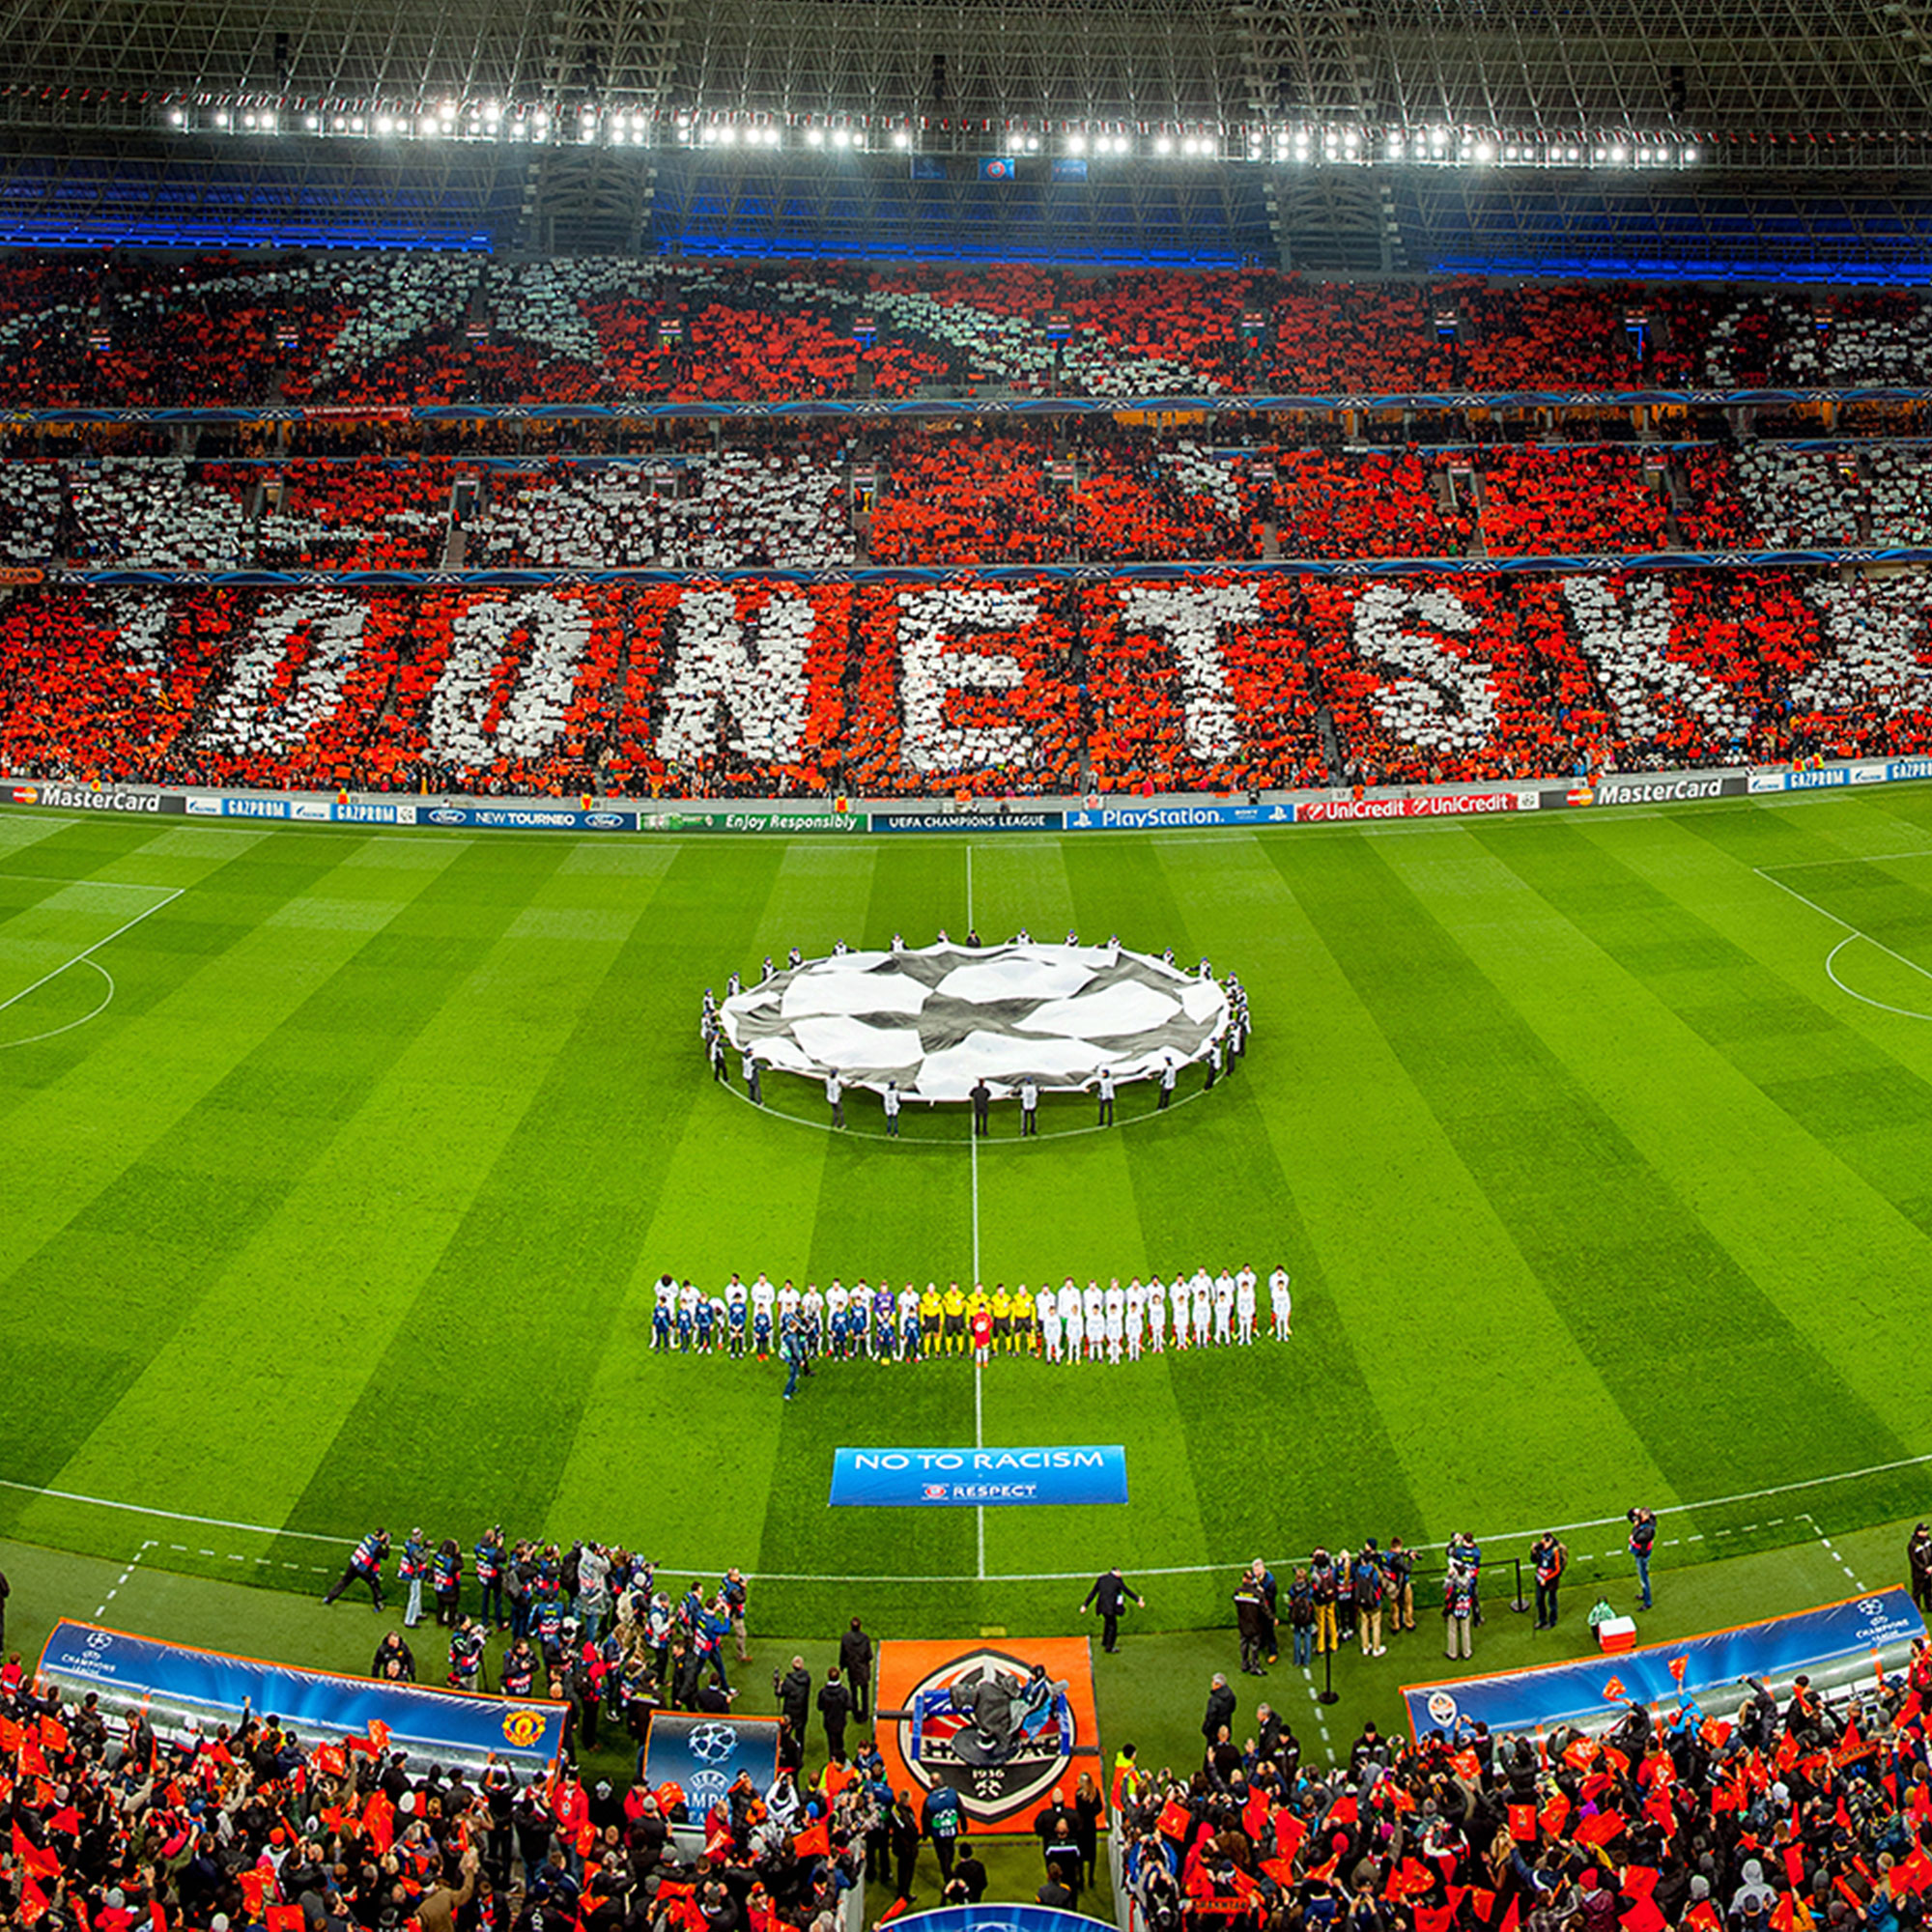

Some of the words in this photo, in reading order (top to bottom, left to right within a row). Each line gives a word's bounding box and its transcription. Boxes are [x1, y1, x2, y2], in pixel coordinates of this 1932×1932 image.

[1791, 770, 1843, 788] GAZPROM
[1892, 762, 1932, 779] GAZPRO
[42, 788, 160, 811] MasterCard
[1598, 779, 1722, 804] MasterCard
[228, 800, 285, 816] GAZPROM
[1326, 802, 1405, 819] UniCredit
[1431, 794, 1508, 813] UniCredit
[337, 805, 394, 821] GAZPROM
[475, 812, 507, 824] NEW
[508, 813, 576, 825] TOURNEO
[889, 817, 922, 828] UEFA
[923, 816, 996, 828] CHAMPIONS
[999, 814, 1046, 826] LEAGUE
[725, 814, 766, 831] Enjoy
[771, 814, 858, 831] Responsibly
[854, 1454, 910, 1470] NO
[917, 1454, 964, 1470] TO
[973, 1451, 1104, 1469] RACISM
[952, 1484, 1037, 1497] RESPECT
[972, 1770, 1006, 1779] 1936
